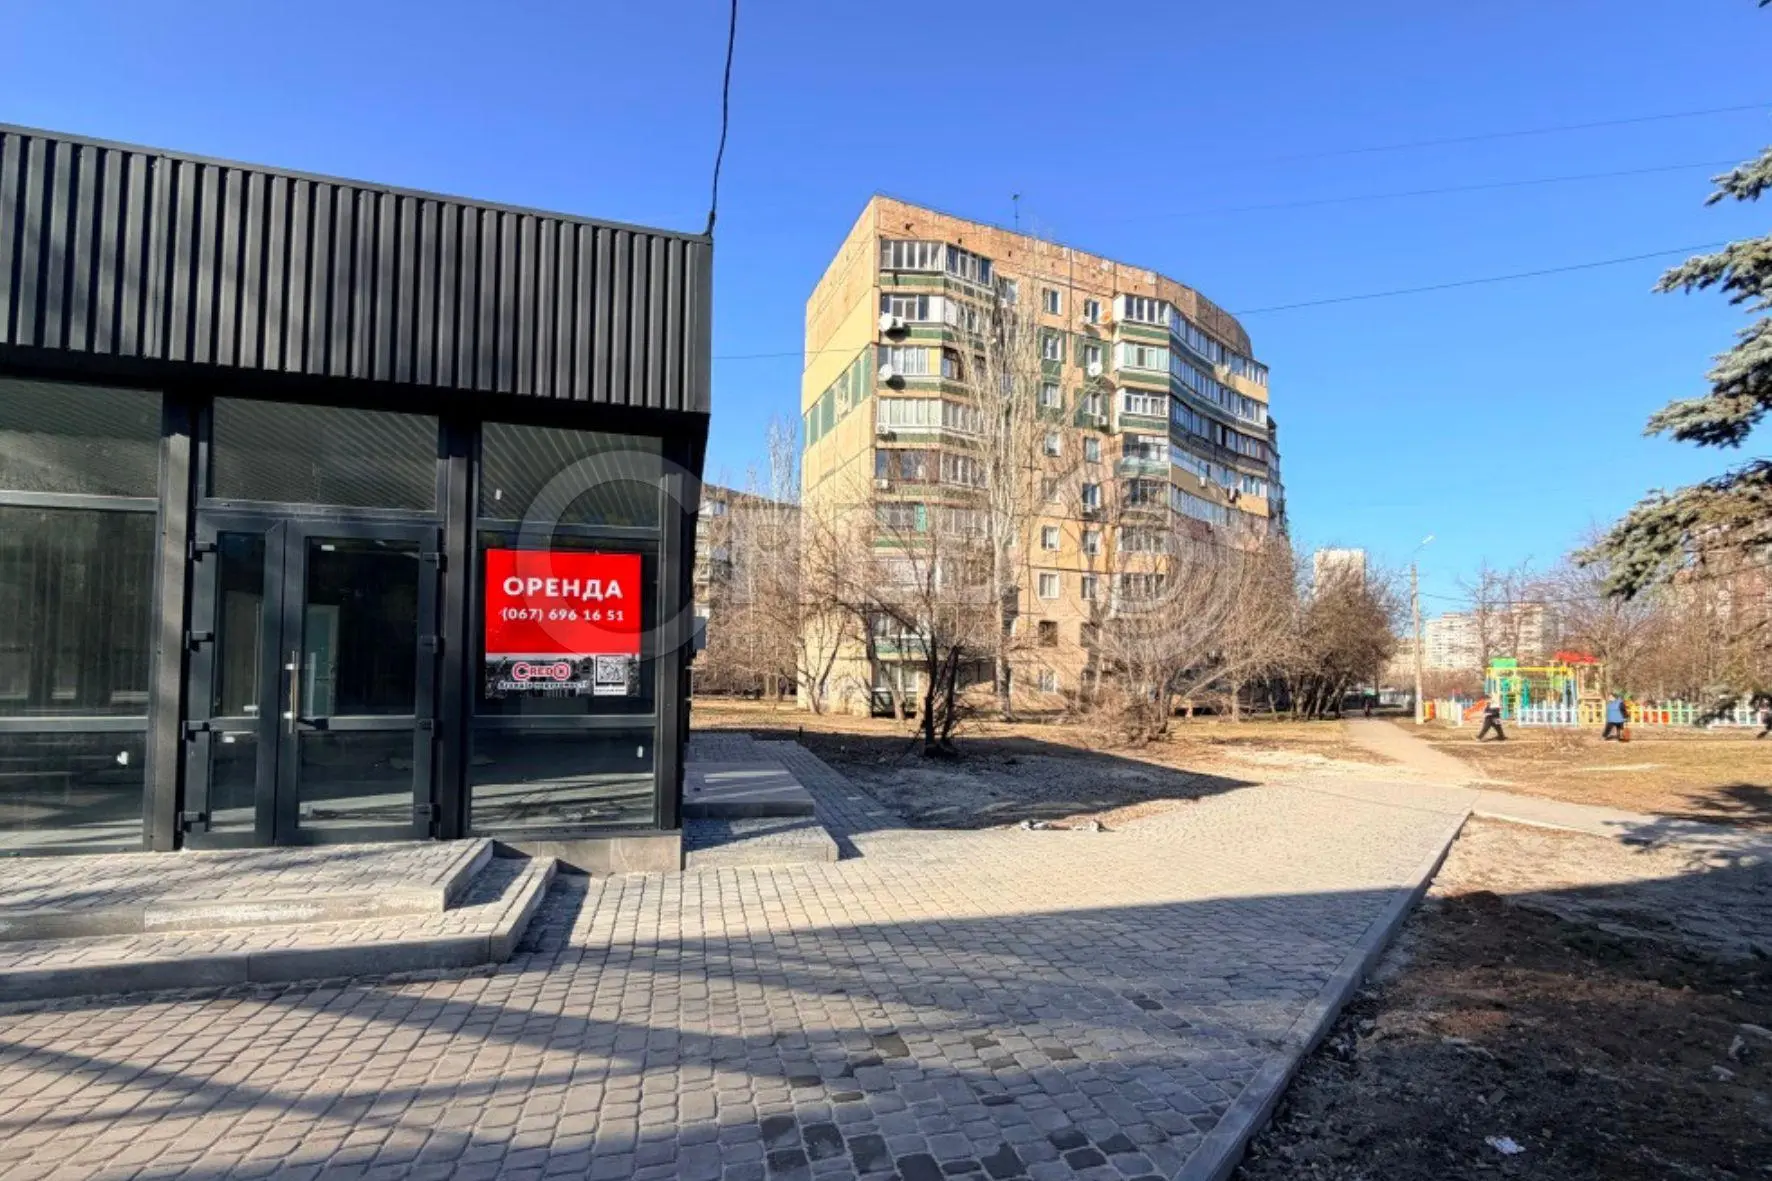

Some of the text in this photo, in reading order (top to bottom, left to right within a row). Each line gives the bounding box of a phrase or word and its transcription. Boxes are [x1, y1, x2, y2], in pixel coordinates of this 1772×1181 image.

[503, 577, 622, 601] ОРЕНДА
[502, 608, 624, 622] (067) 696 16 51
